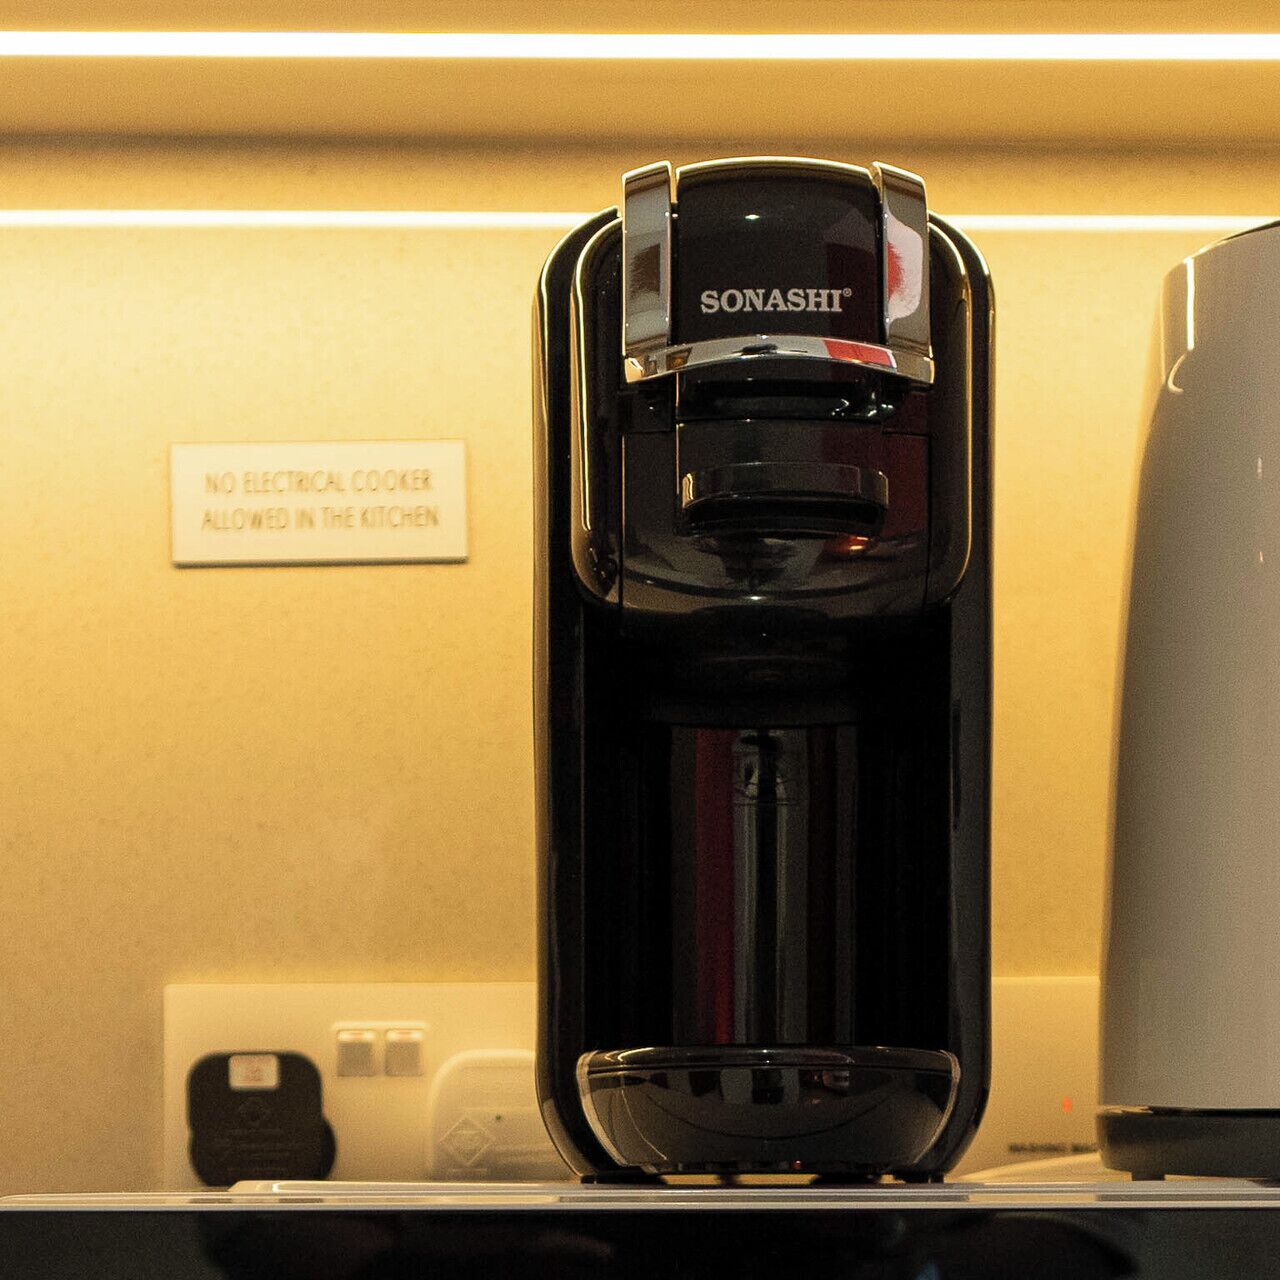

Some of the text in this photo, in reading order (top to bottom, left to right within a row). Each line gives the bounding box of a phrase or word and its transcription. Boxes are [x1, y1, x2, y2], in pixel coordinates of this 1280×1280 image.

[205, 469, 433, 494] NO ELECTRICAL COOKER
[202, 505, 439, 530] ALLOWED IN THE KITCHEN
